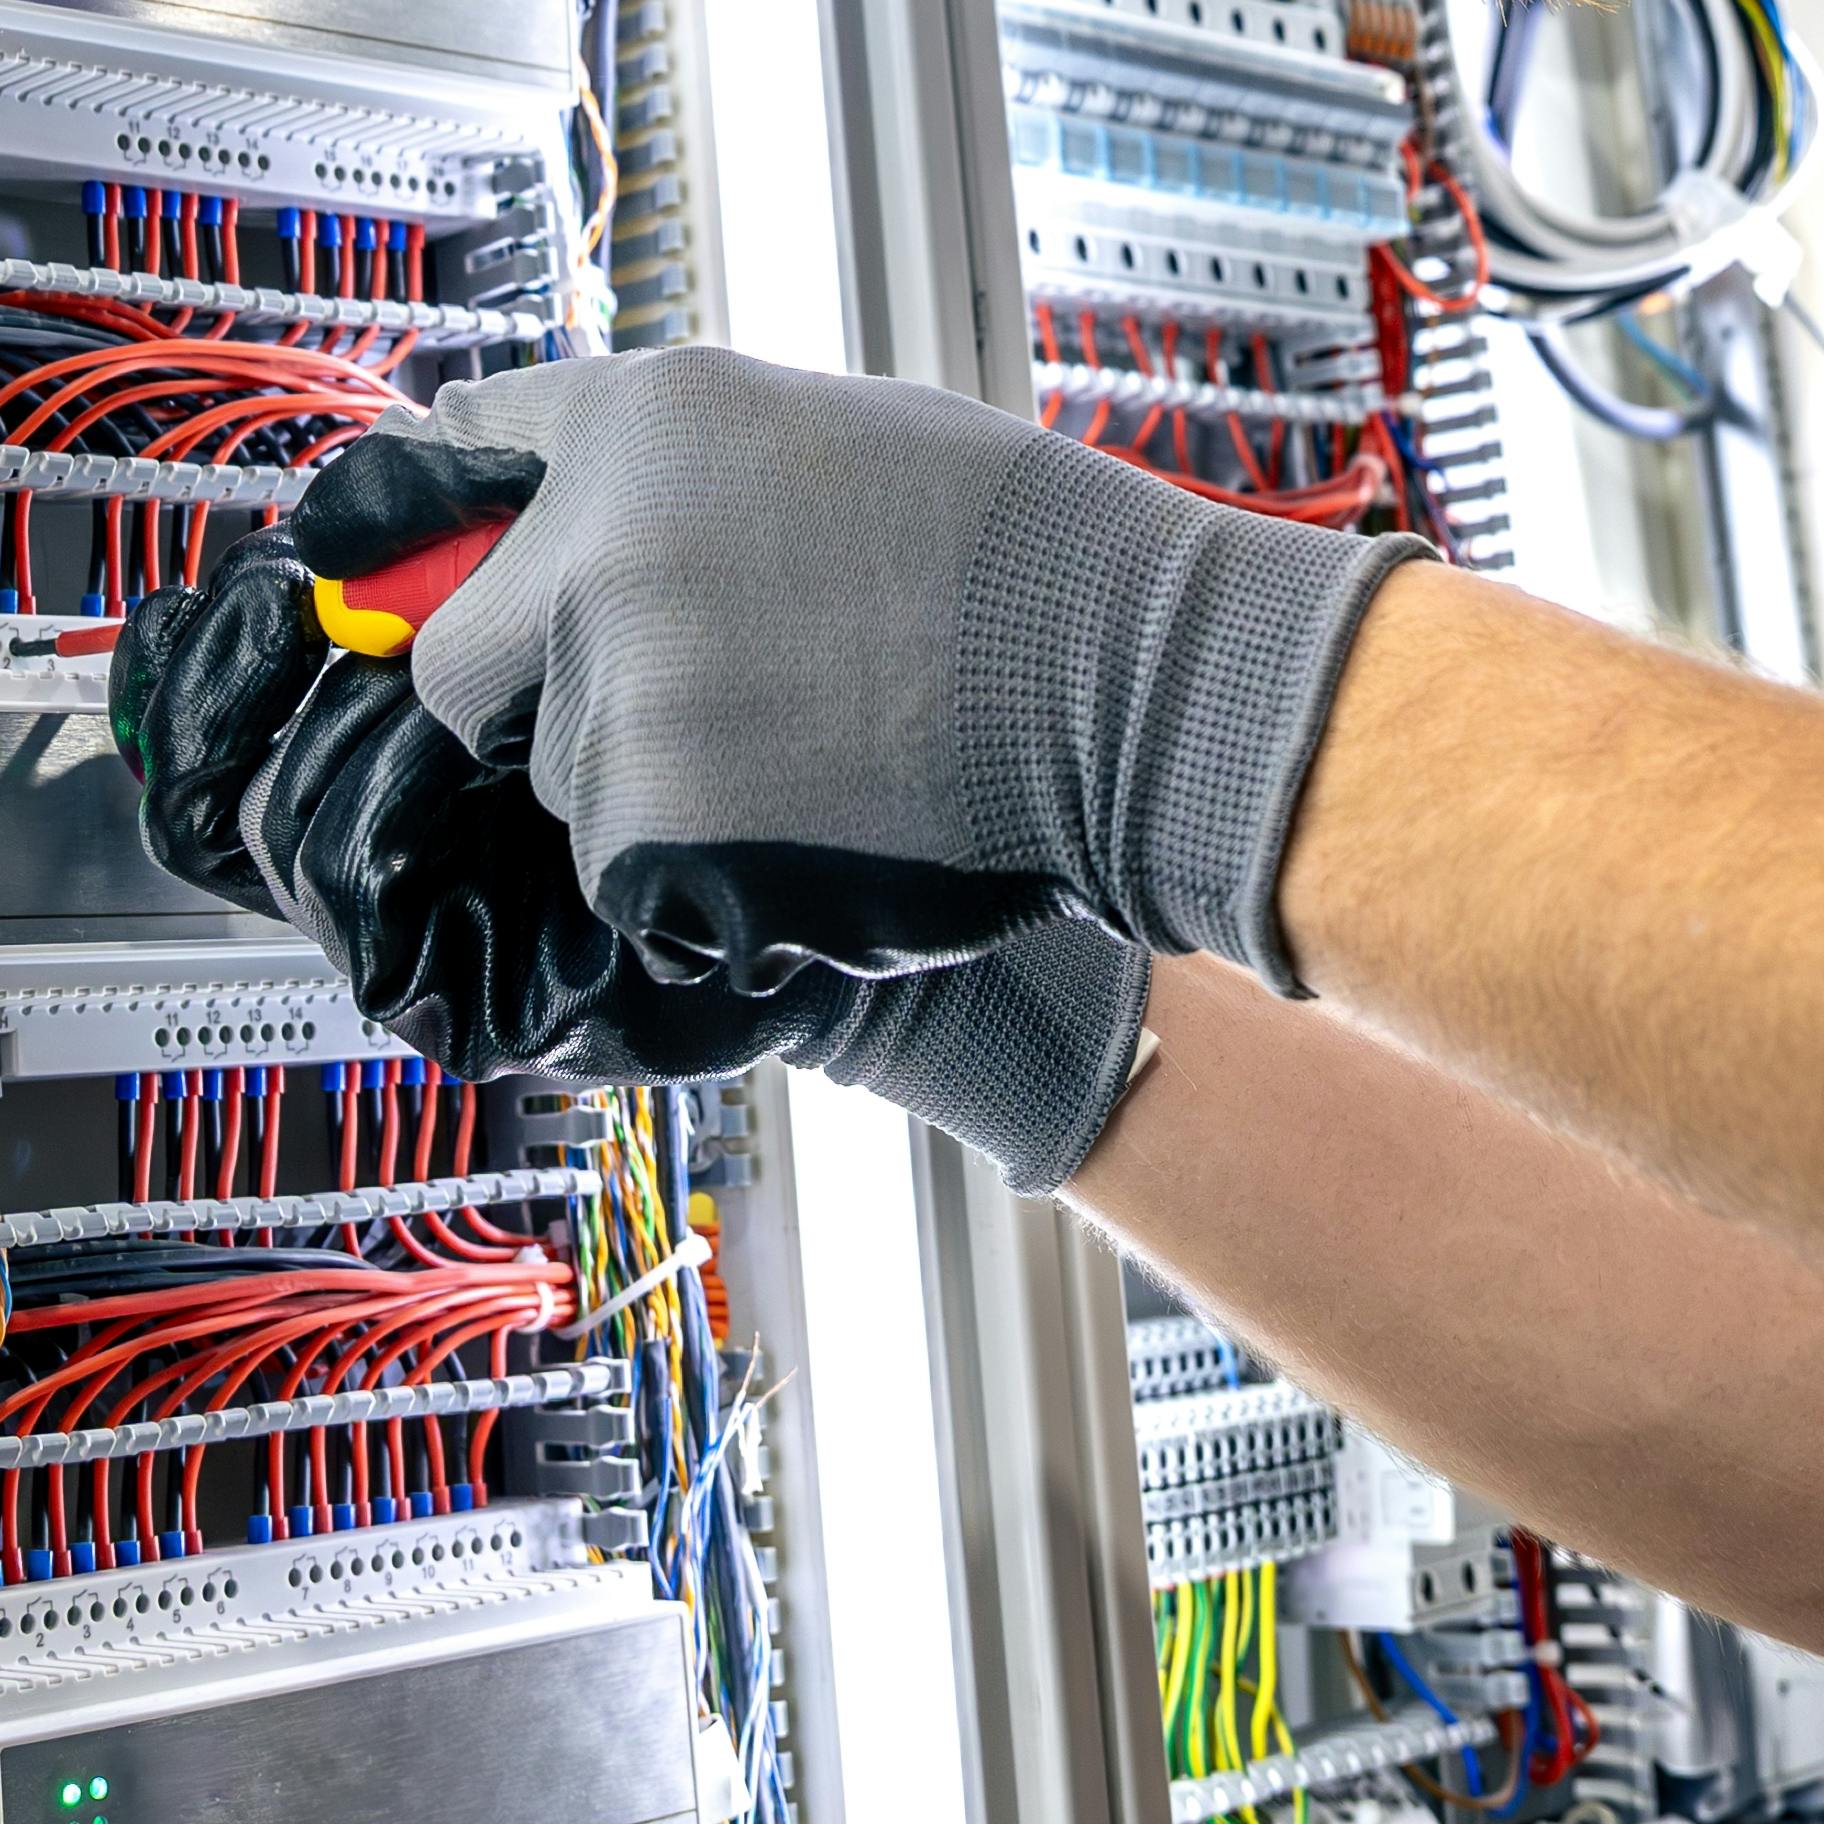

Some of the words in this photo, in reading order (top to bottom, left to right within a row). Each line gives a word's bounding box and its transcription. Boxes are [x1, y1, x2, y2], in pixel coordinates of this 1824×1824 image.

[3, 657, 12, 670] 2
[47, 658, 56, 672] 3
[0, 1015, 9, 1030] H
[165, 1012, 179, 1026] 11
[206, 1010, 222, 1024] 12
[247, 1008, 263, 1022] 13
[288, 1006, 303, 1021] 14
[35, 1633, 45, 1648] 2
[82, 1624, 92, 1639] 3
[125, 1617, 135, 1632] 4
[172, 1608, 182, 1623] 5
[216, 1600, 226, 1615] 6
[301, 1587, 309, 1601] 7
[343, 1578, 352, 1593] 8
[384, 1571, 393, 1586] 9
[421, 1564, 435, 1579] 10
[501, 1550, 514, 1565] 12
